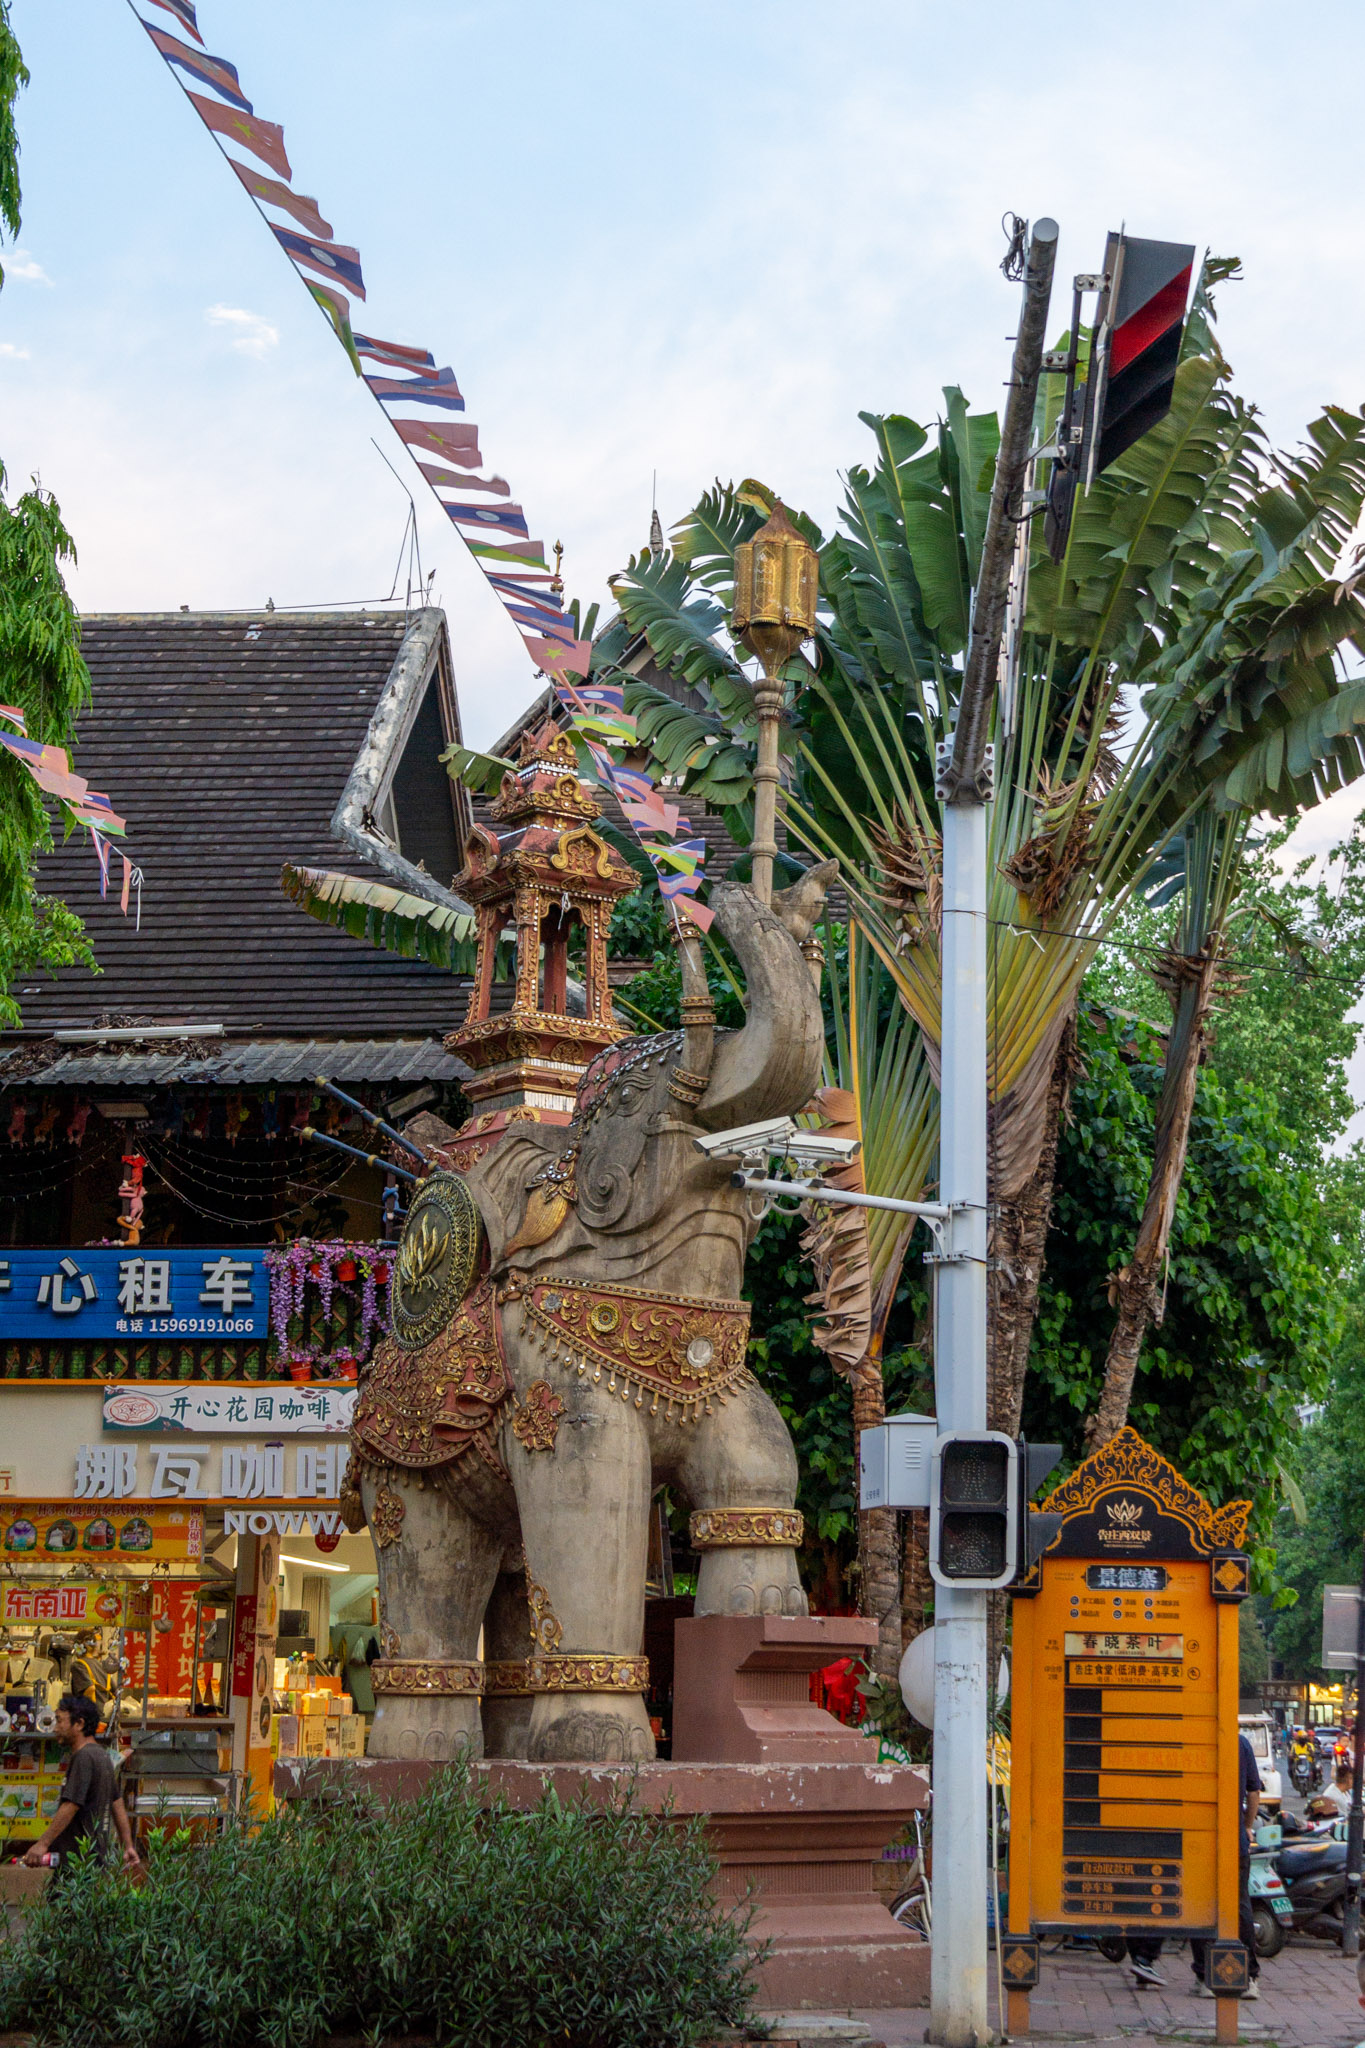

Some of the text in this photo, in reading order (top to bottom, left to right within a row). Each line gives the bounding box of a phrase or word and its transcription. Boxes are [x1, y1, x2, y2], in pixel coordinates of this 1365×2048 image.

[116, 1318, 255, 1333] 电话 15969191066
[168, 1396, 332, 1422] 开心花园咖啡
[73, 1444, 348, 1500] 挪瓦咖啡
[1098, 1567, 1158, 1588] 景德寨
[6, 1587, 88, 1619] 东南亚
[1083, 1634, 1163, 1650] 春晓茶叶
[1084, 1901, 1114, 1913] 卫生间
